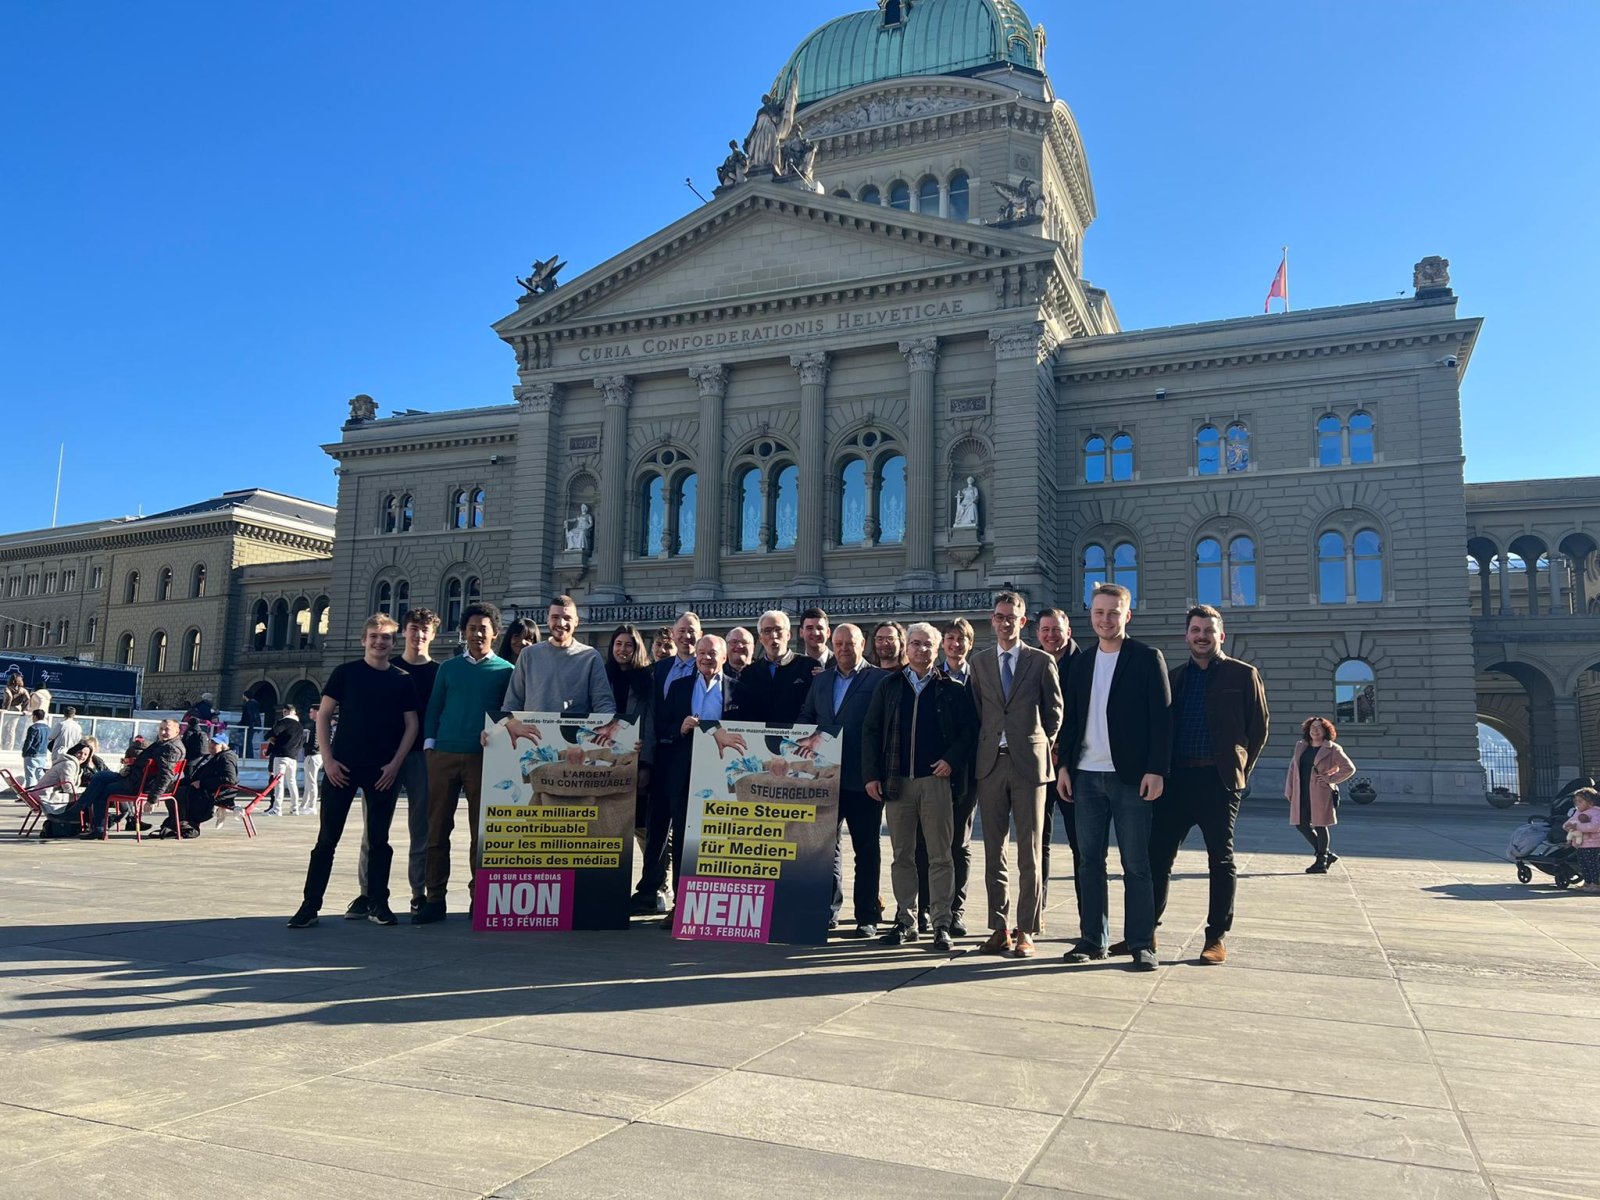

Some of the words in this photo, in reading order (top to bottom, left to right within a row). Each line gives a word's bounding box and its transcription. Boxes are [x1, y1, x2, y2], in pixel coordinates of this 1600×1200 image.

[578, 344, 632, 361] CURIA
[642, 319, 824, 354] CONFOEDERATIONIS
[836, 300, 964, 330] HELVETICAE
[563, 770, 613, 778] L'ARGENT
[541, 778, 555, 786] DU
[557, 777, 632, 788] CONTRIBUABLE
[750, 784, 830, 799] STEUERGELDER
[487, 806, 512, 817] Non
[516, 809, 538, 817] aux
[542, 807, 596, 818] milliards
[705, 802, 749, 817] Keine
[754, 804, 814, 820] Steuer-
[486, 823, 502, 833] du
[505, 823, 585, 834] contribuable
[703, 822, 782, 838] milliarden
[485, 839, 514, 851] pour
[518, 839, 537, 849] les
[540, 839, 621, 849] millionnaires
[701, 841, 725, 853] für
[729, 842, 794, 857] Medien-
[483, 855, 542, 865] zurichois
[546, 855, 569, 865] des
[572, 854, 617, 865] médias
[698, 860, 778, 876] millionäre
[489, 873, 501, 881] LOI
[503, 873, 517, 881] SUR
[519, 873, 533, 881] LES
[534, 872, 562, 881] MÉDIAS
[686, 880, 766, 894] MEDIENGESETZ
[487, 882, 561, 916] NON
[682, 891, 765, 928] NEIN
[486, 917, 498, 927] LE
[502, 917, 514, 927] 13
[517, 915, 559, 927] FÉVRIER
[680, 925, 696, 935] AM
[700, 926, 713, 936] 13.
[716, 927, 761, 938] FEBRUAR
